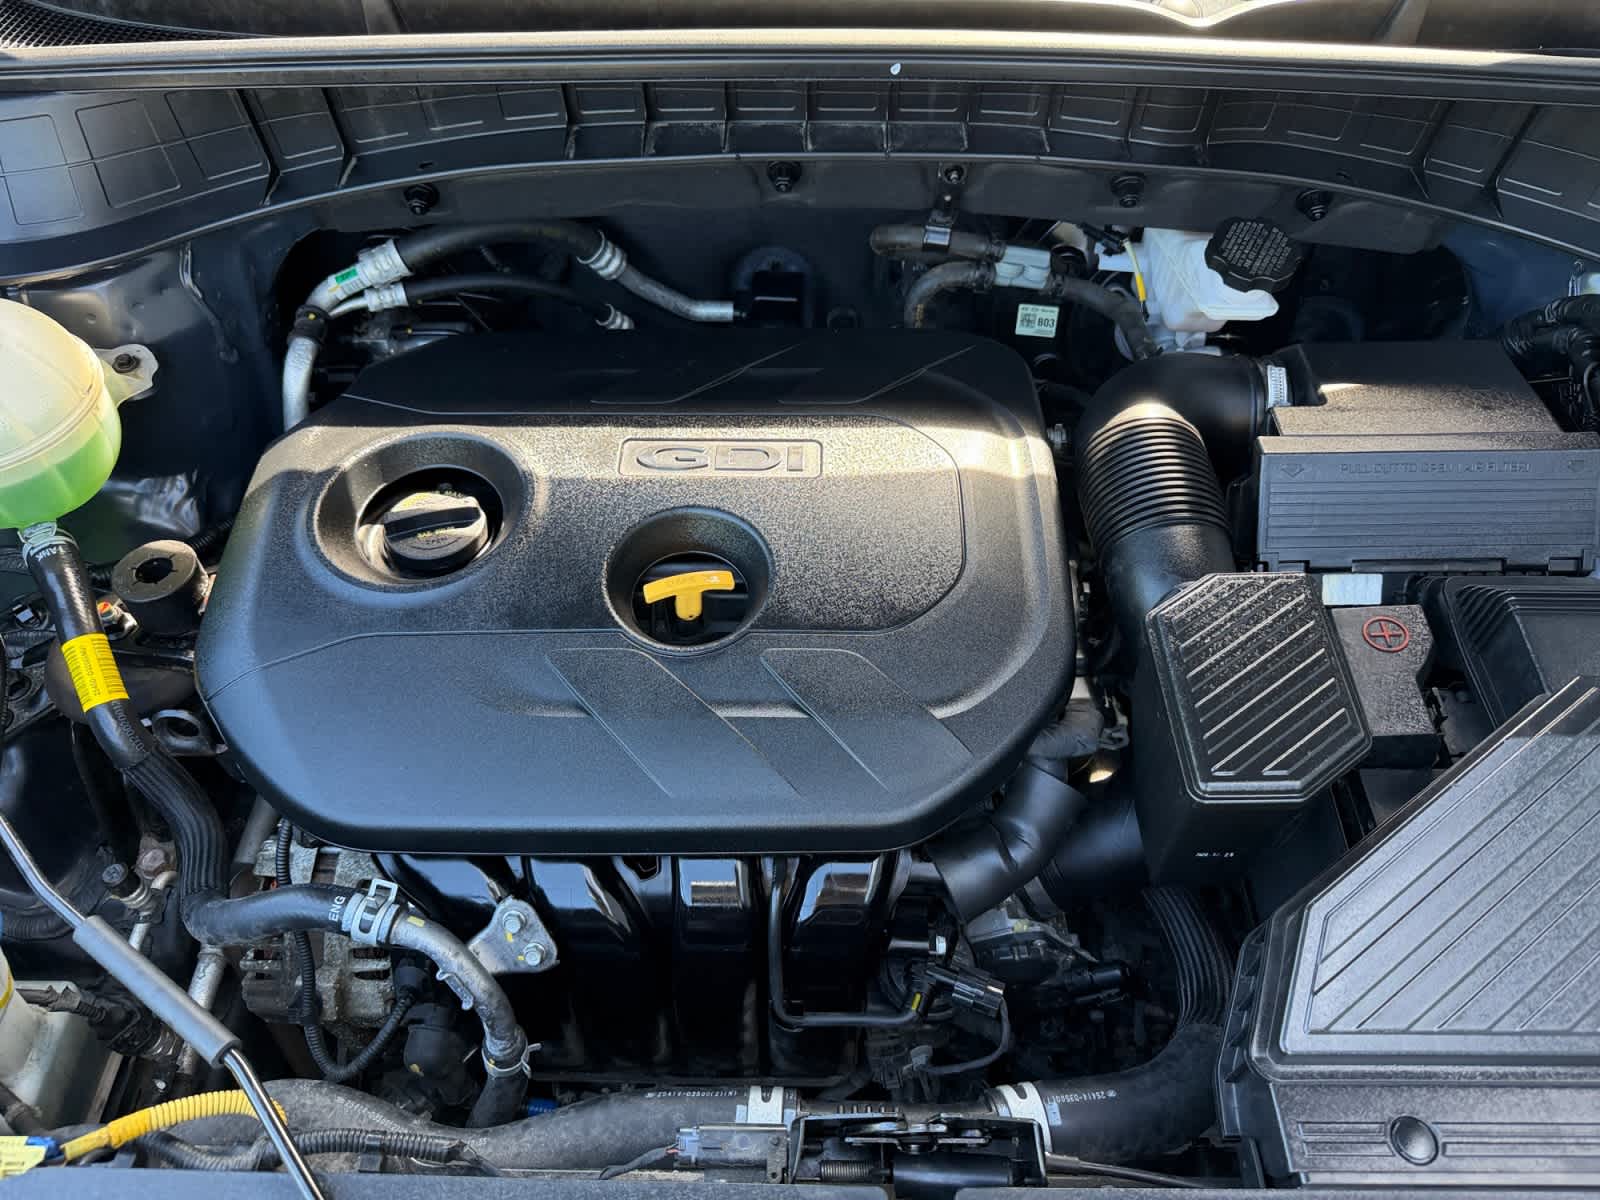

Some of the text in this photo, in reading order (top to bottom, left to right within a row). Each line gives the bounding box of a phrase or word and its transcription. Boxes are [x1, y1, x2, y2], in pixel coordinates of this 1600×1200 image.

[636, 447, 804, 472] GDI
[1340, 463, 1371, 473] PULL
[328, 895, 346, 922] ENG
